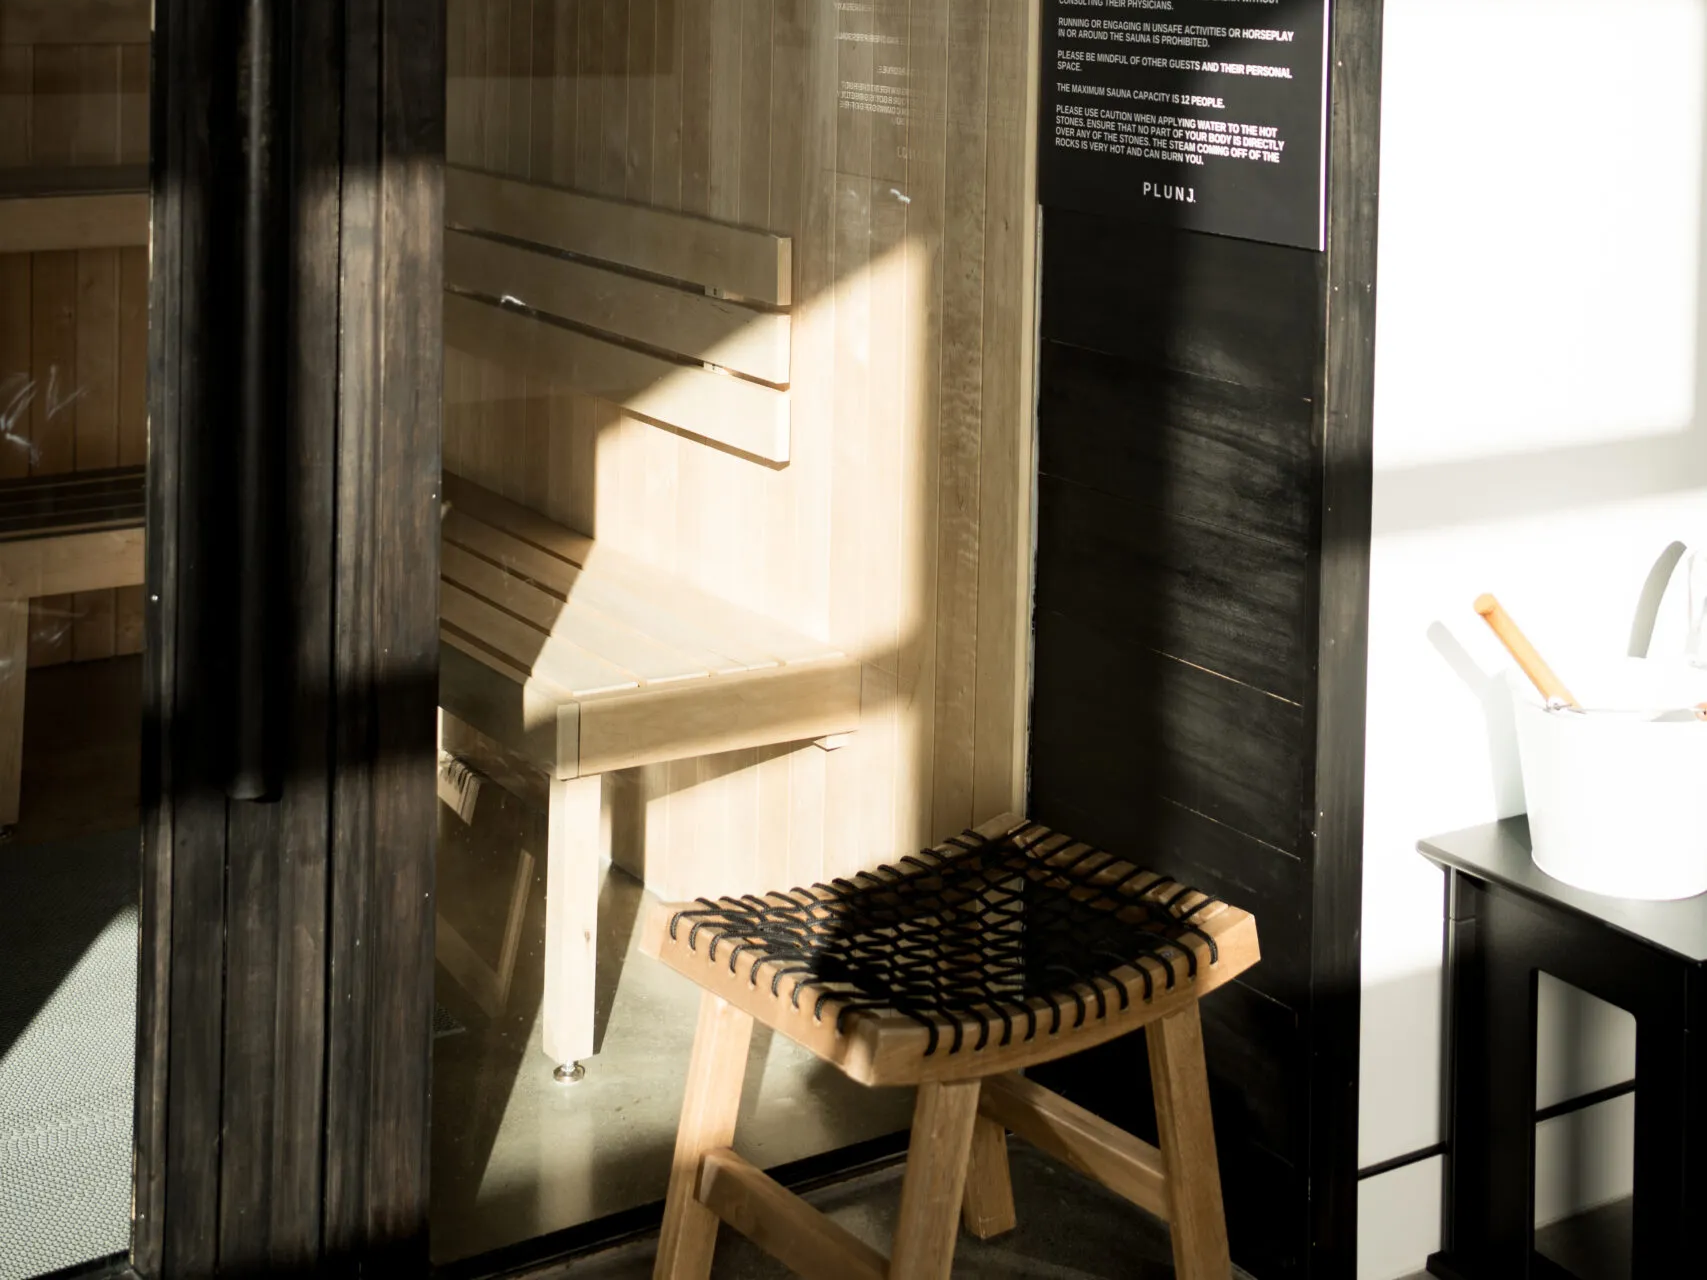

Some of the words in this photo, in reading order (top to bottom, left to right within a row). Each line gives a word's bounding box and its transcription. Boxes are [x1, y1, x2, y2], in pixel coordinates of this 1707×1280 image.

[1058, 29, 1065, 37] IN
[1067, 30, 1077, 38] OR
[1079, 30, 1108, 40] AROUND
[1110, 32, 1124, 41] THE
[1126, 33, 1151, 43] SAUNA
[1153, 35, 1160, 44] IS
[1162, 36, 1210, 47] PROHIBITED.
[1057, 62, 1082, 71] SPACE.
[1056, 83, 1070, 93] THE
[1072, 84, 1105, 96] MAXIMUM
[1107, 88, 1131, 99] SAUNA
[1133, 90, 1170, 102] CAPACITY
[1172, 93, 1179, 103] IS
[1181, 94, 1190, 104] 12
[1191, 95, 1225, 108] PEOPLE.
[1055, 138, 1079, 149] ROCKS
[1081, 141, 1088, 150] IS
[1089, 142, 1108, 153] VERY
[1110, 144, 1125, 155] HOT
[1127, 146, 1142, 157] AND
[1144, 148, 1160, 159] CAN
[1162, 151, 1183, 162] BURN
[1185, 154, 1204, 165] YOU.
